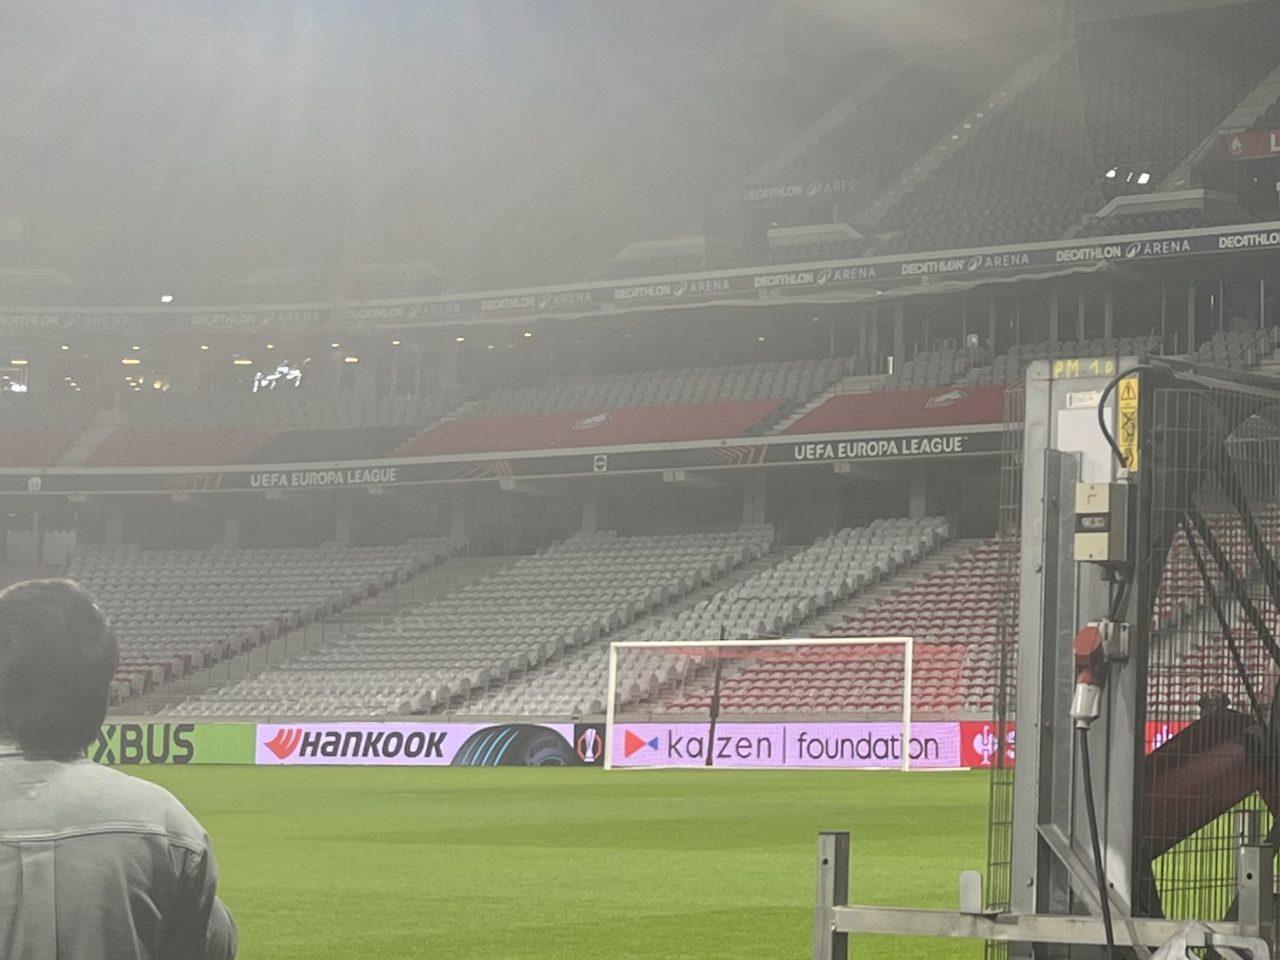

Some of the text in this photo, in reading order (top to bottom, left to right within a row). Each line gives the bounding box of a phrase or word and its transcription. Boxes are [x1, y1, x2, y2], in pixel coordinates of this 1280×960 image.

[1056, 240, 1191, 262] DECATHLON ARENA
[901, 253, 1030, 276] DECATHLON ARENA
[754, 266, 876, 288] DECATHLON ARENA
[794, 437, 962, 460] UEFA EUROPA LEAGUE
[250, 468, 397, 487] UEFA EUROPA LEAGUE
[667, 729, 939, 759] kazen foundation
